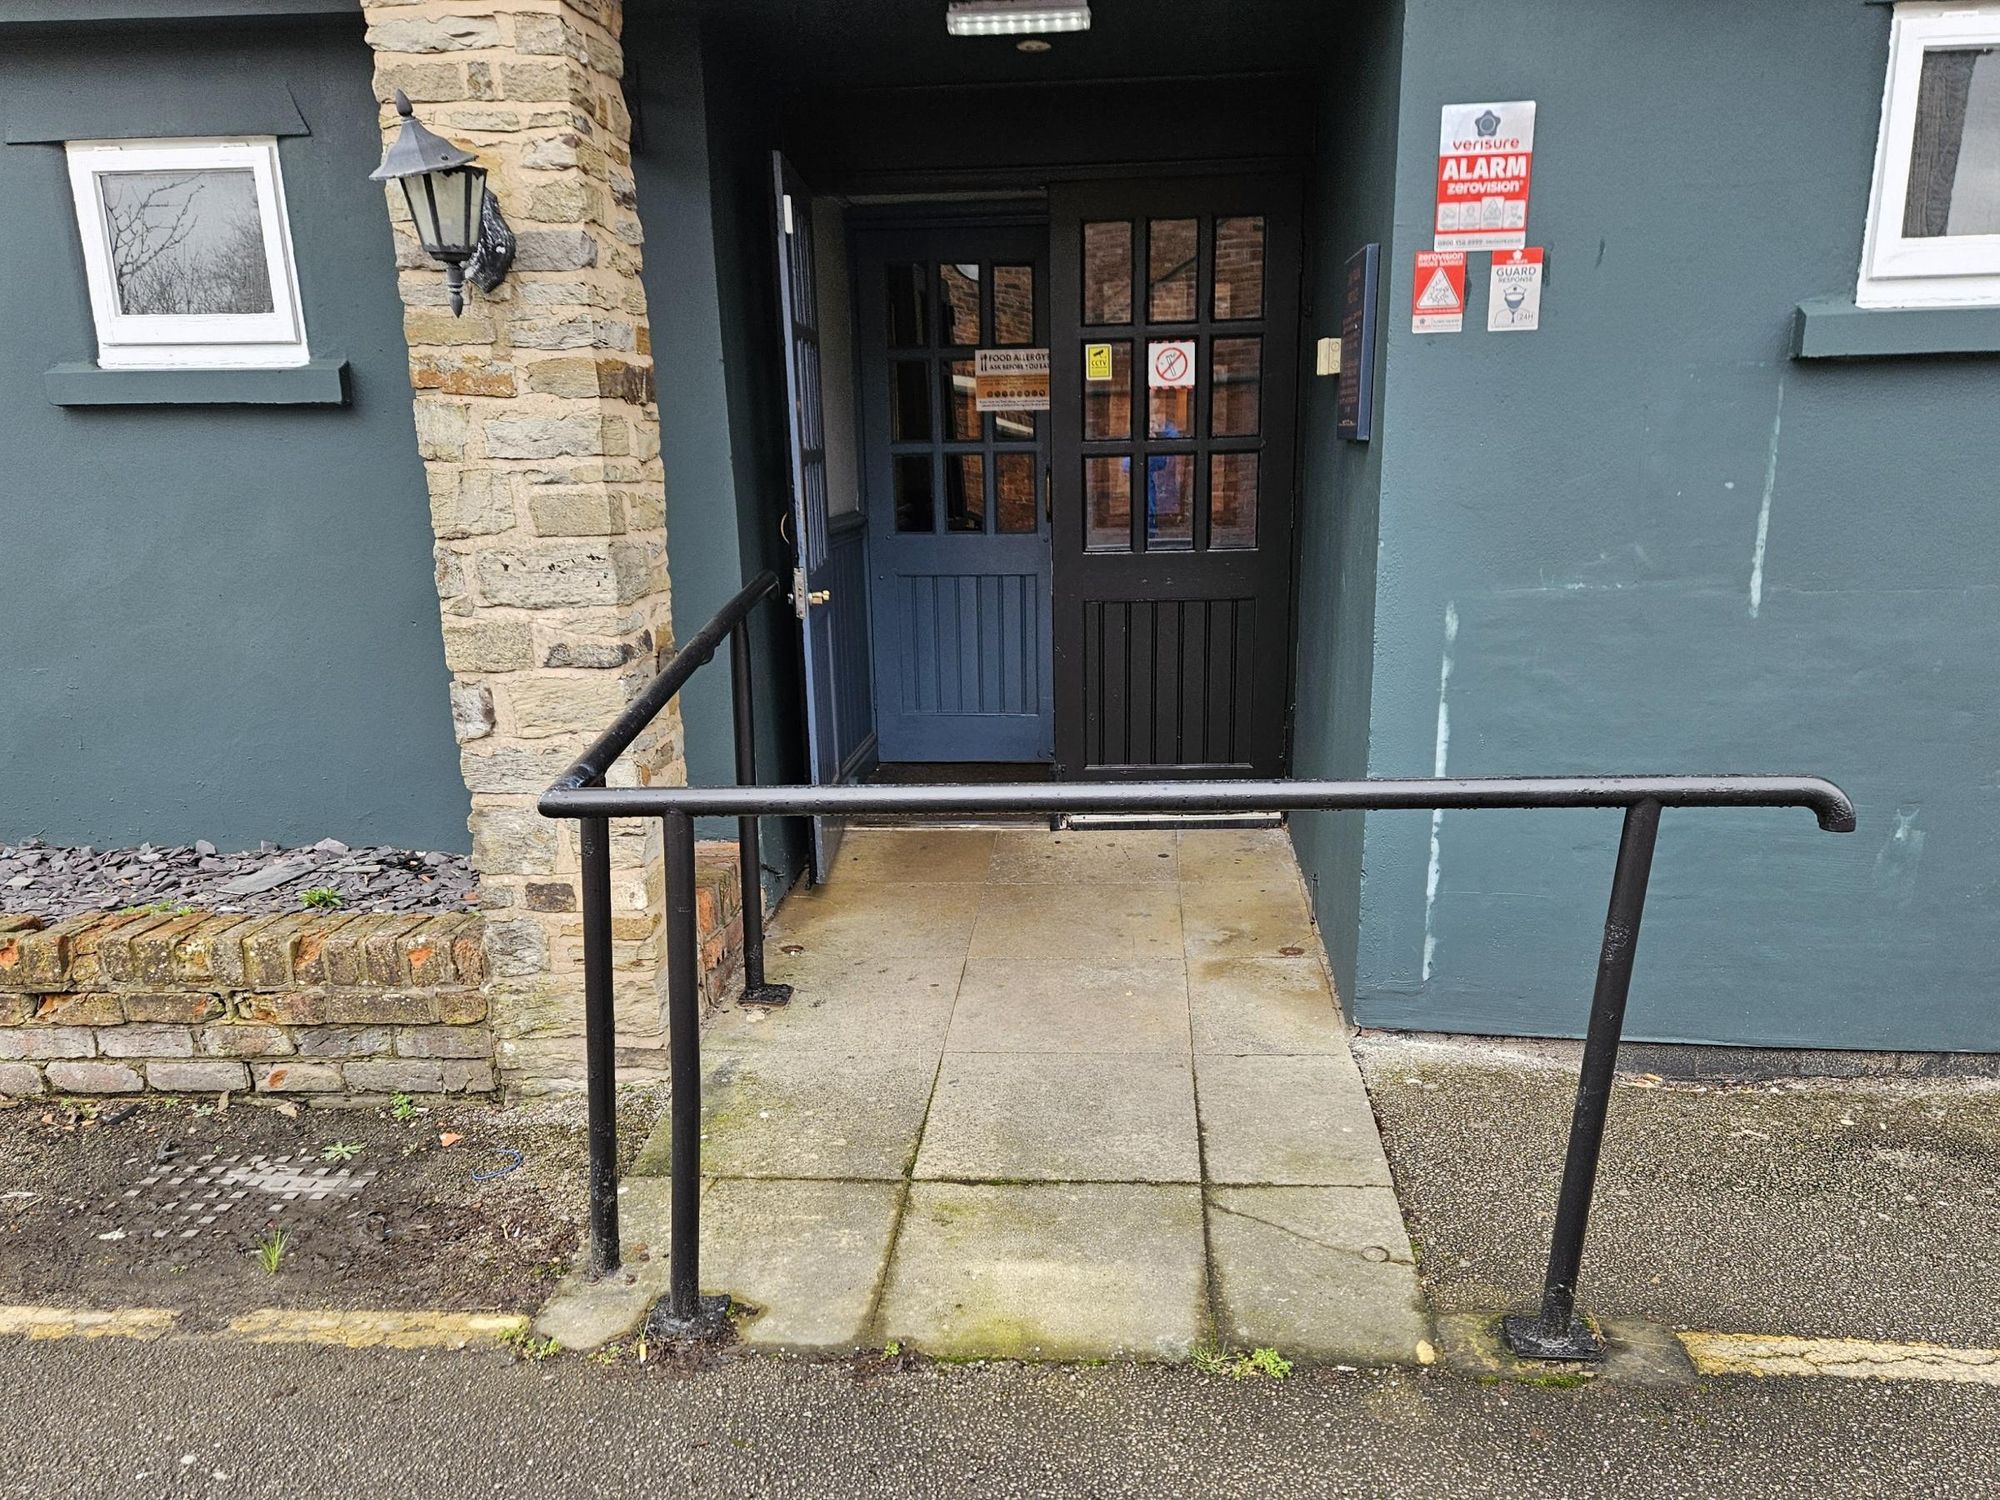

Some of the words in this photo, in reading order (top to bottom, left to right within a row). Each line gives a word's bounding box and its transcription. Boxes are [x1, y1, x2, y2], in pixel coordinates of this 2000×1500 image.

[1453, 138, 1519, 150] verisure
[1442, 156, 1527, 181] ALARM
[1447, 181, 1520, 195] zerovision
[1496, 266, 1537, 277] GUARD
[989, 354, 1012, 362] FOOD
[1025, 362, 1039, 370] YOU
